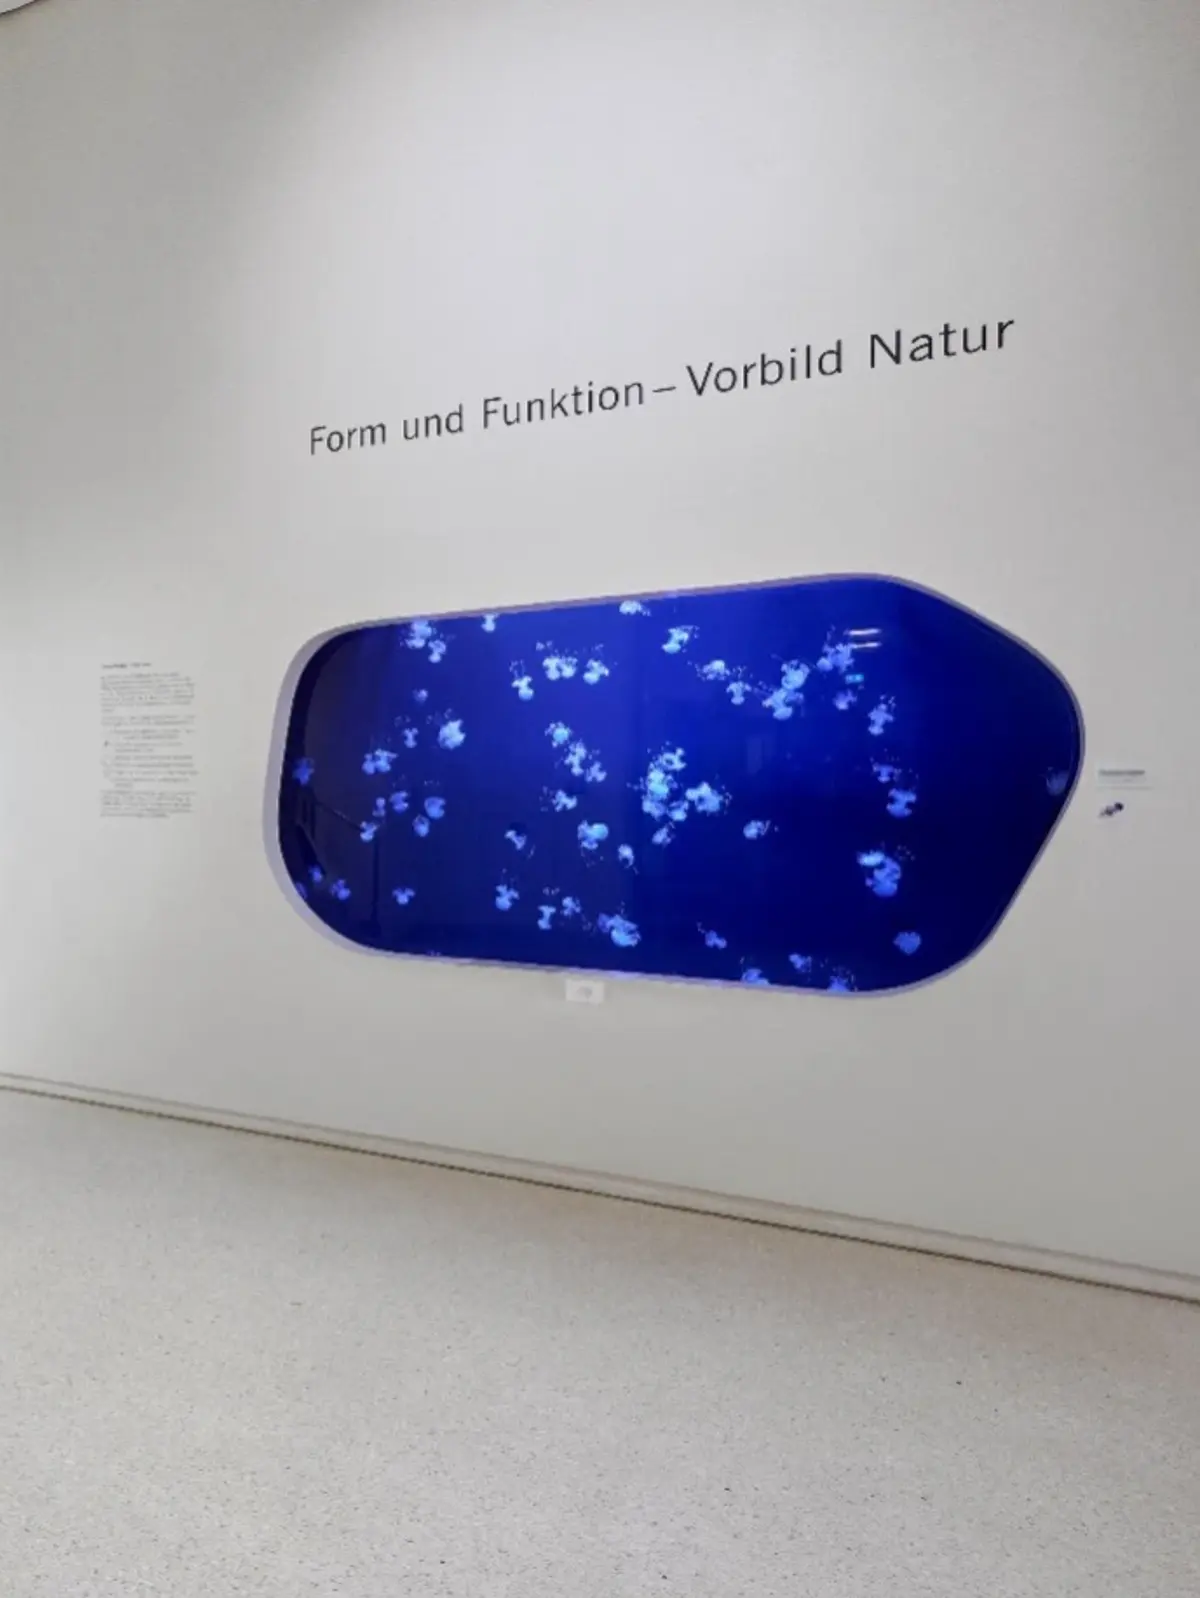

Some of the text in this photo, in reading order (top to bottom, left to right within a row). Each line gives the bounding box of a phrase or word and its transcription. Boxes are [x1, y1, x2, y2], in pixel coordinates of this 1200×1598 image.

[310, 423, 388, 456] Form
[402, 402, 465, 442] und
[482, 380, 645, 430] Funktion
[685, 338, 843, 397] Vorbild
[869, 319, 1016, 370] Natur
